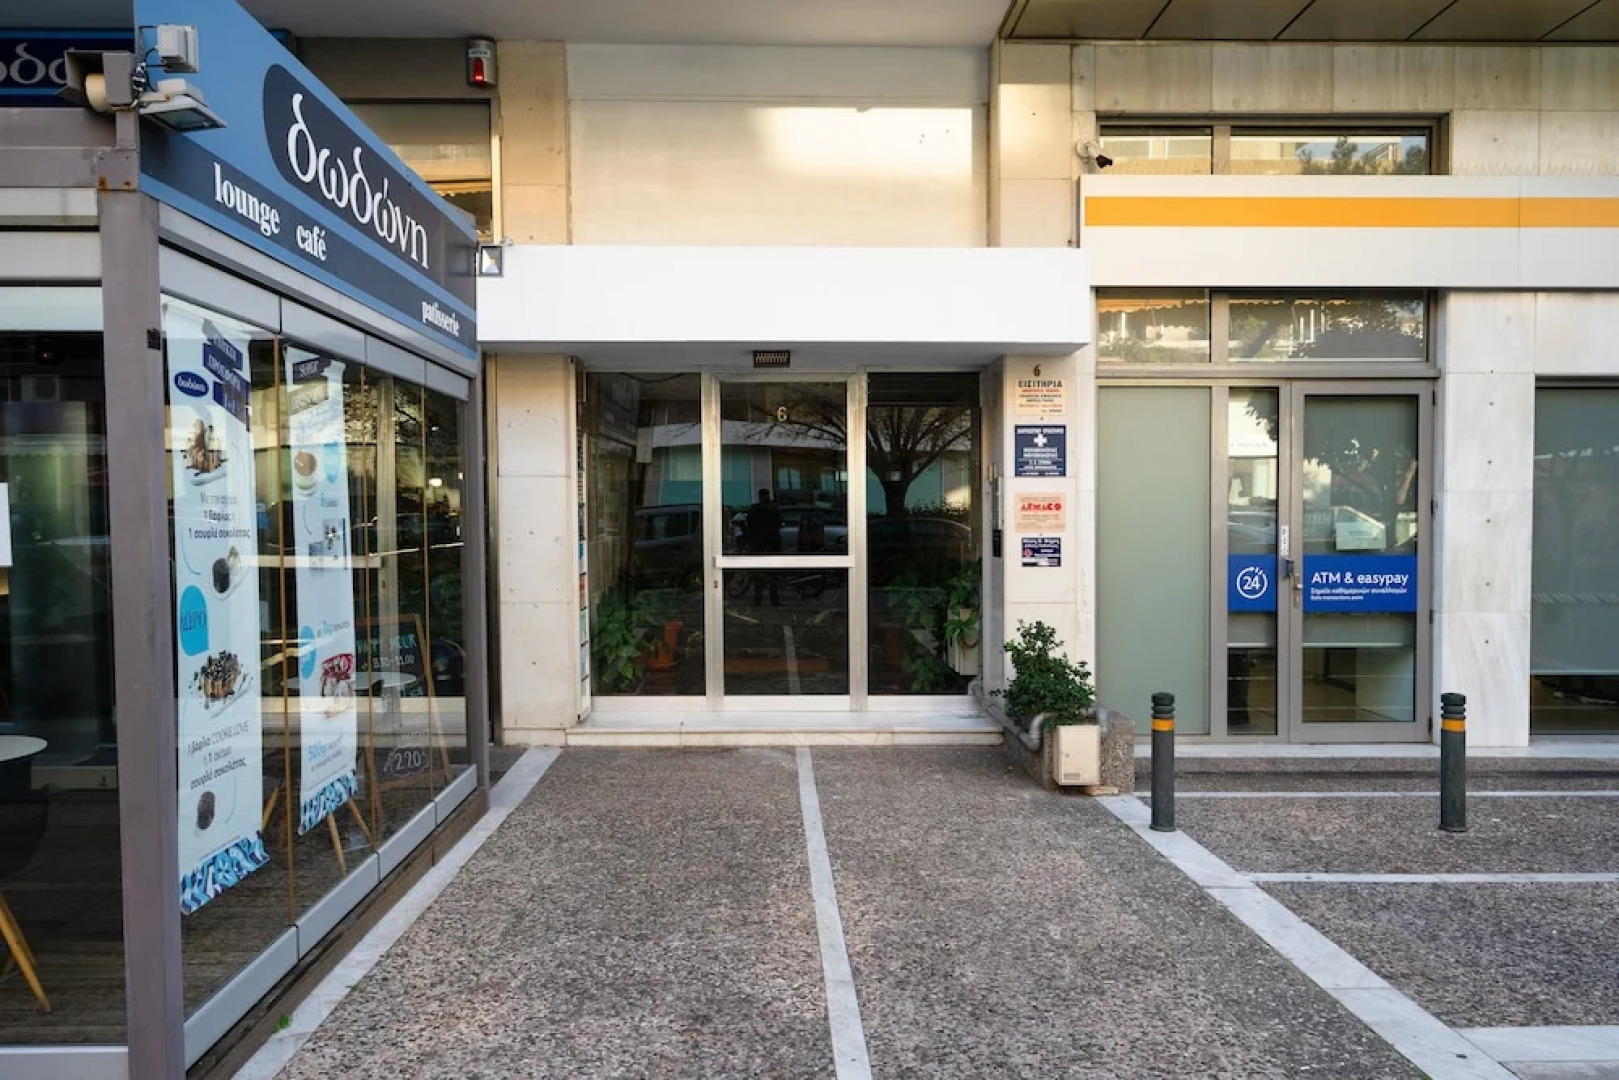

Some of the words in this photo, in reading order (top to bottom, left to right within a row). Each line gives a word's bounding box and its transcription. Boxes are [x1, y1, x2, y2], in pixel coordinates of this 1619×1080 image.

[287, 93, 429, 269] δωδώνη
[213, 162, 280, 236] lounge
[296, 224, 327, 261] café
[421, 300, 460, 337] patisserie
[1033, 364, 1041, 377] 6
[1243, 576, 1261, 590] 24
[1311, 572, 1340, 583] ATM
[1344, 572, 1354, 583] &
[1357, 574, 1409, 587] easypay
